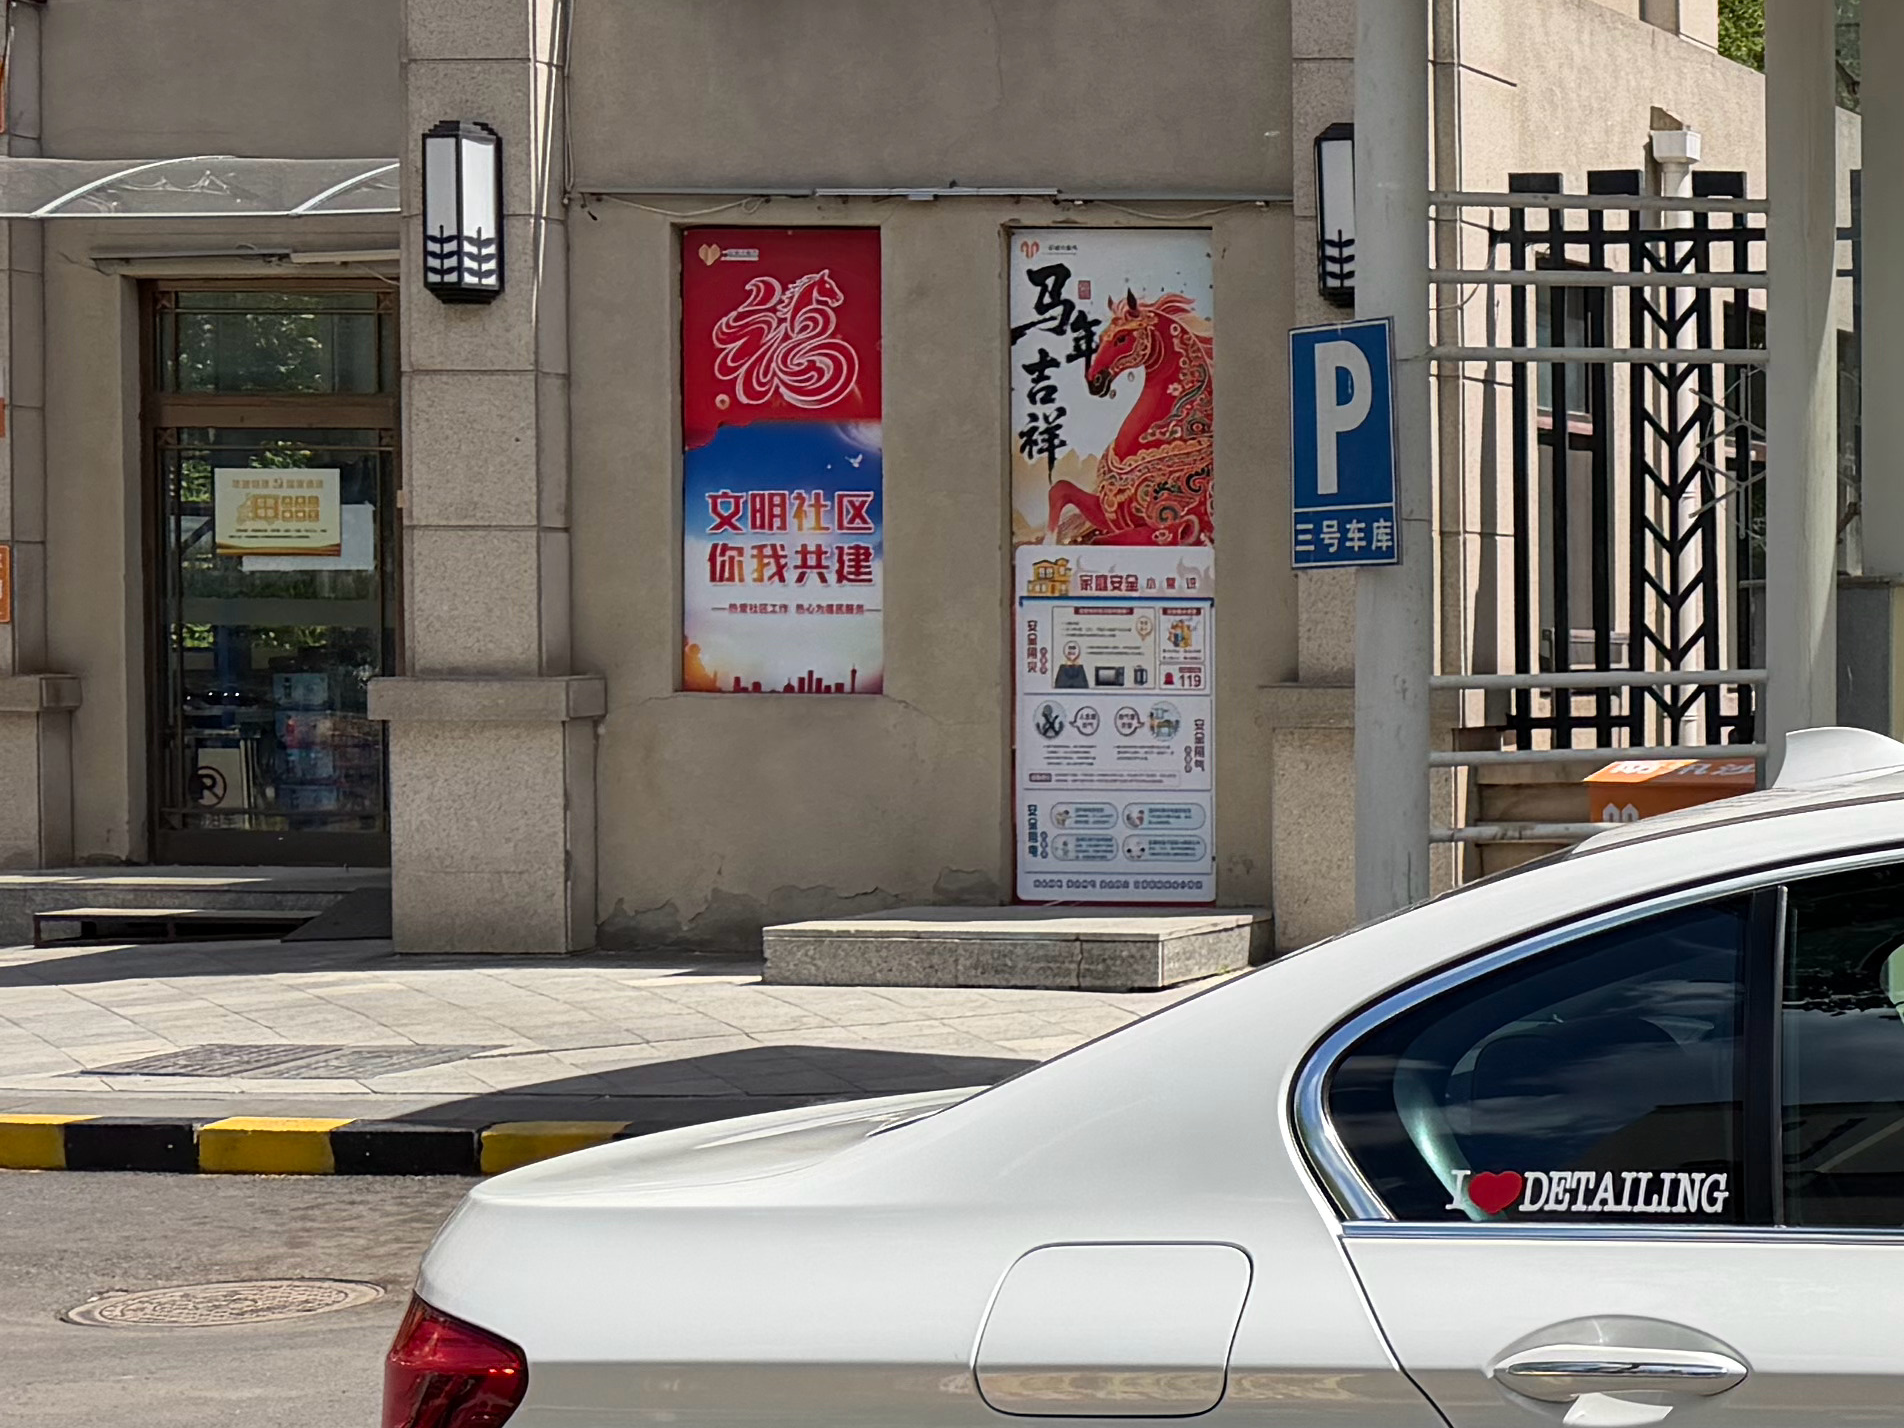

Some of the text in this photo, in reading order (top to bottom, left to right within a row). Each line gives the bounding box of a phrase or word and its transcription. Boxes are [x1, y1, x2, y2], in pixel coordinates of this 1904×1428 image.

[1314, 340, 1373, 495] P
[705, 489, 876, 535] 文明社区
[1295, 518, 1394, 553] 三号车库
[706, 542, 875, 586] 你我共建
[1179, 674, 1202, 688] 119
[1445, 1168, 1730, 1214] I DETAILING
